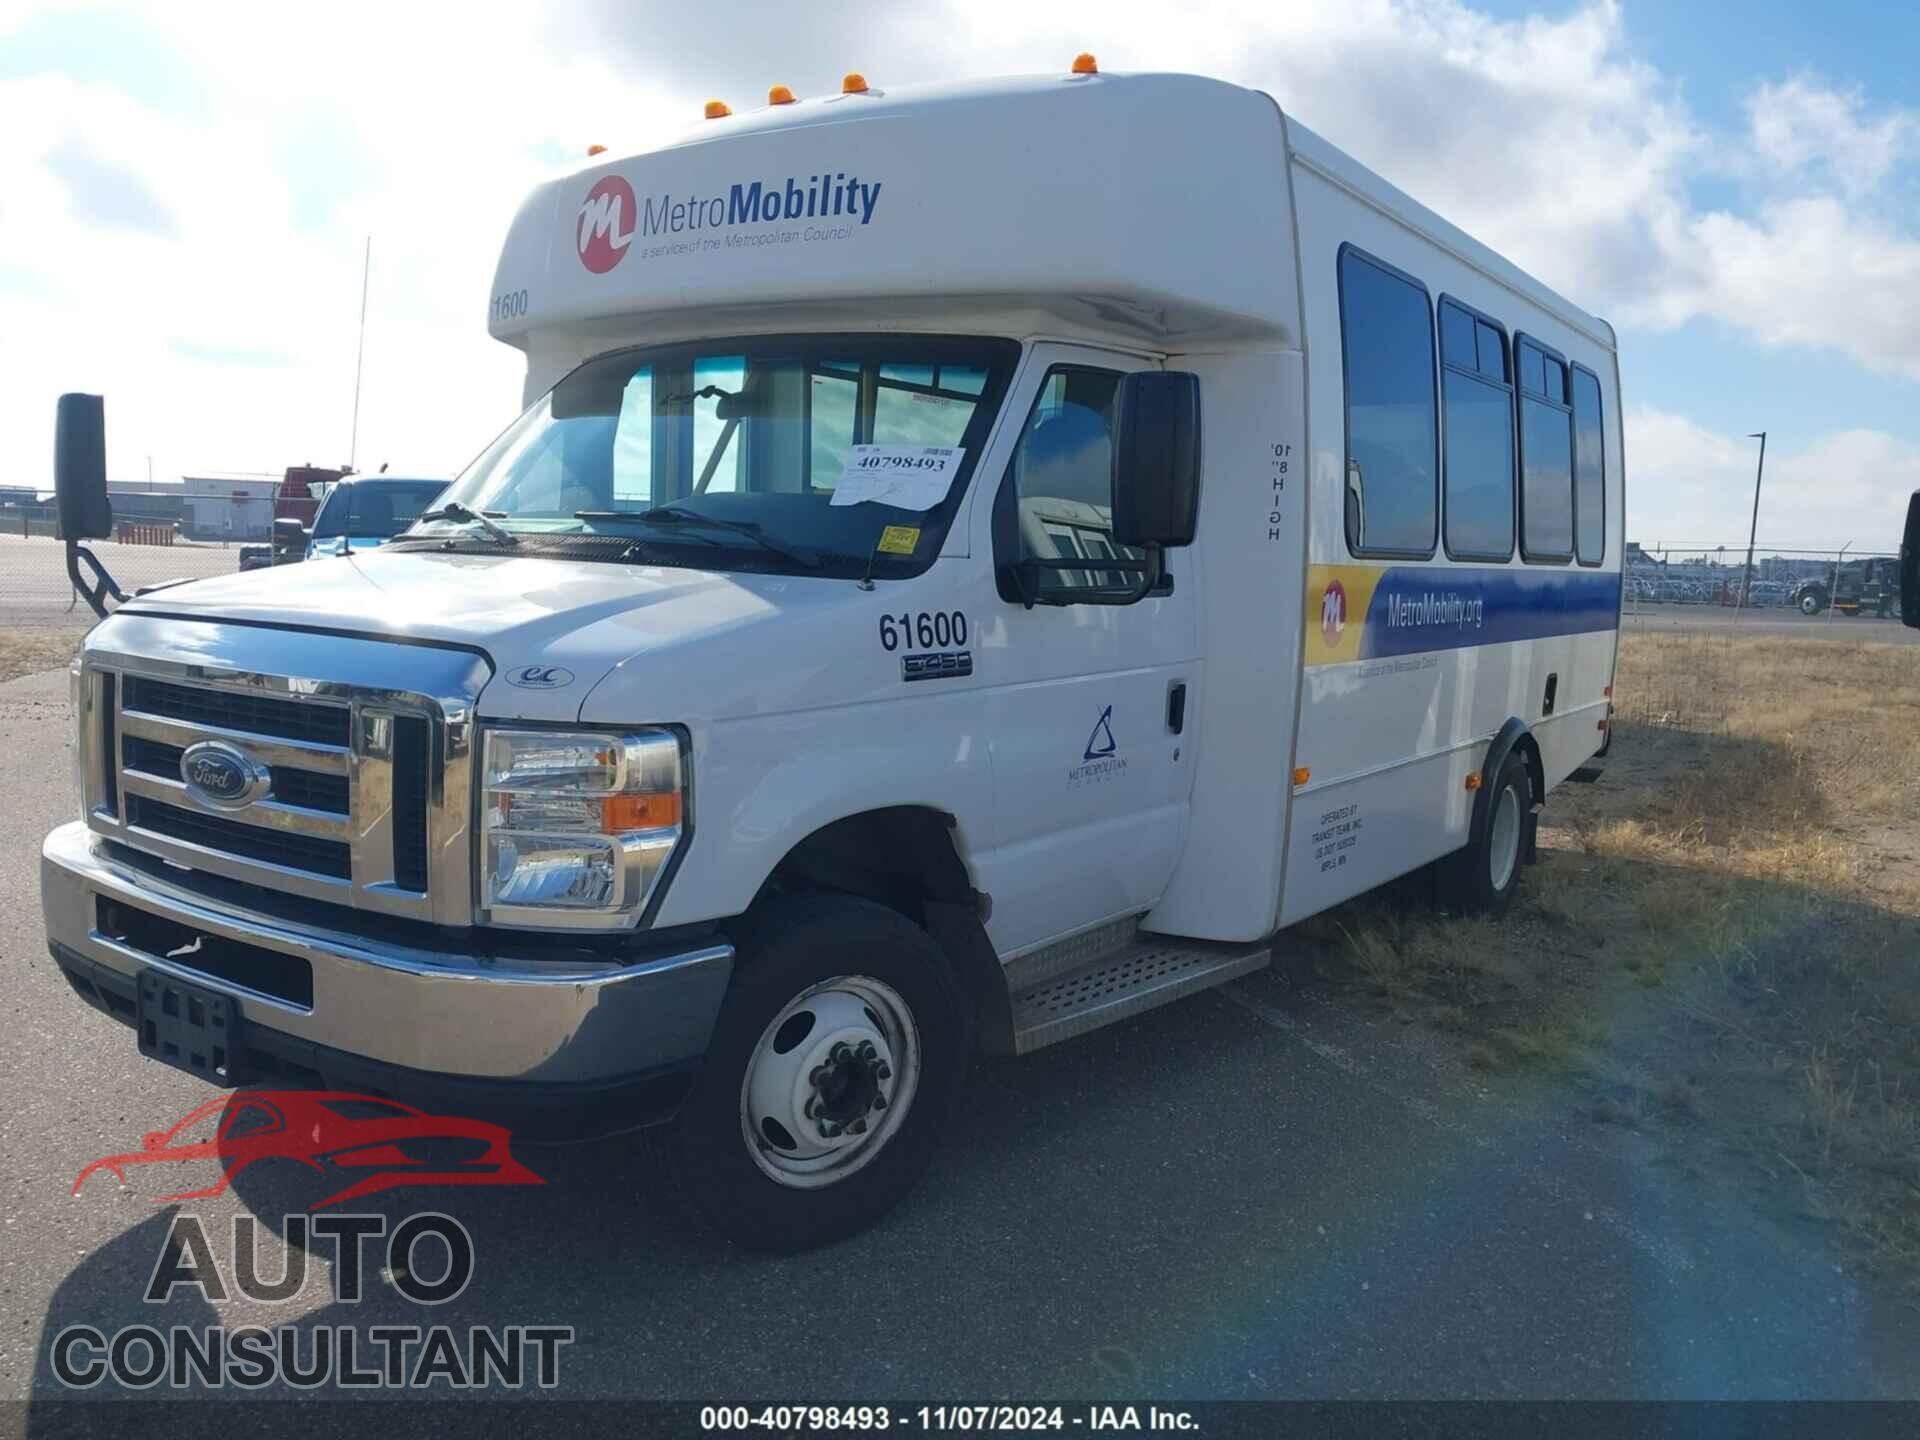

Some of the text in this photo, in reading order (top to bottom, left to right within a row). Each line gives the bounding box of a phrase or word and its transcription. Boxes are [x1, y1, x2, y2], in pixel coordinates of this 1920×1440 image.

[643, 173, 881, 237] MetroMobility
[649, 240, 685, 258] service
[702, 236, 721, 252] the
[724, 228, 800, 250] Metropolitan
[857, 456, 946, 473] 40798493
[1387, 592, 1484, 630] MetroMobility.org
[879, 610, 968, 651] 61600
[193, 758, 230, 789] Ford
